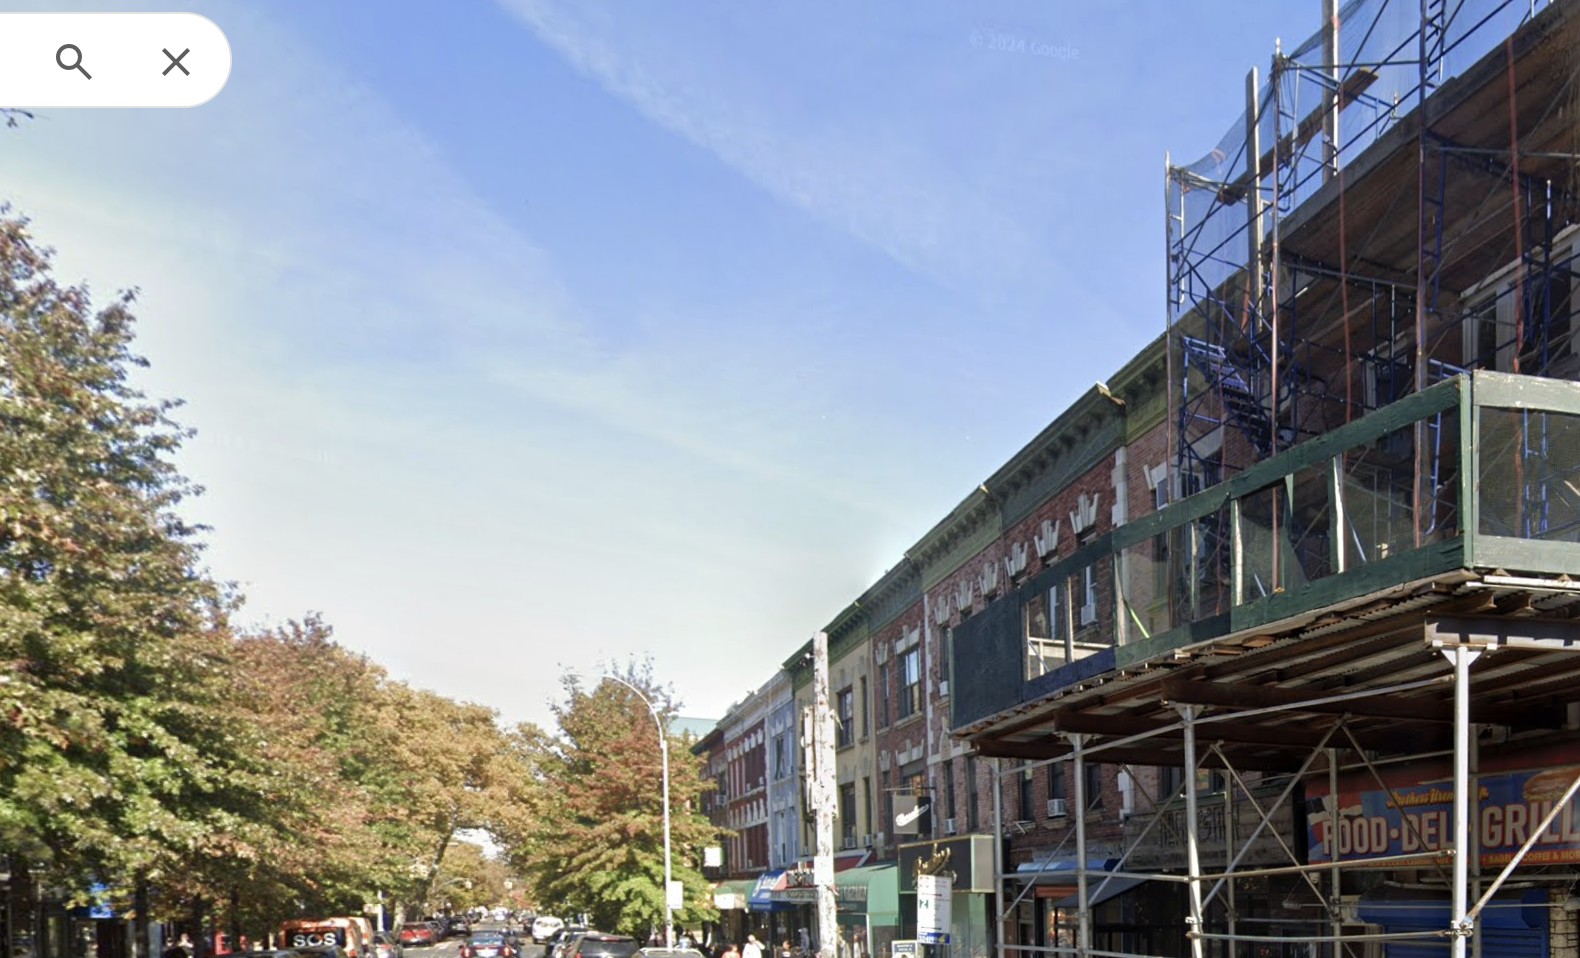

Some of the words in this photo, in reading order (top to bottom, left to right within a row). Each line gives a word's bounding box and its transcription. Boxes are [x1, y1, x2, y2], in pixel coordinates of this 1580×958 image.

[1323, 814, 1389, 855] FOOD
[1402, 810, 1456, 854] DEL
[293, 932, 337, 948] SOS
